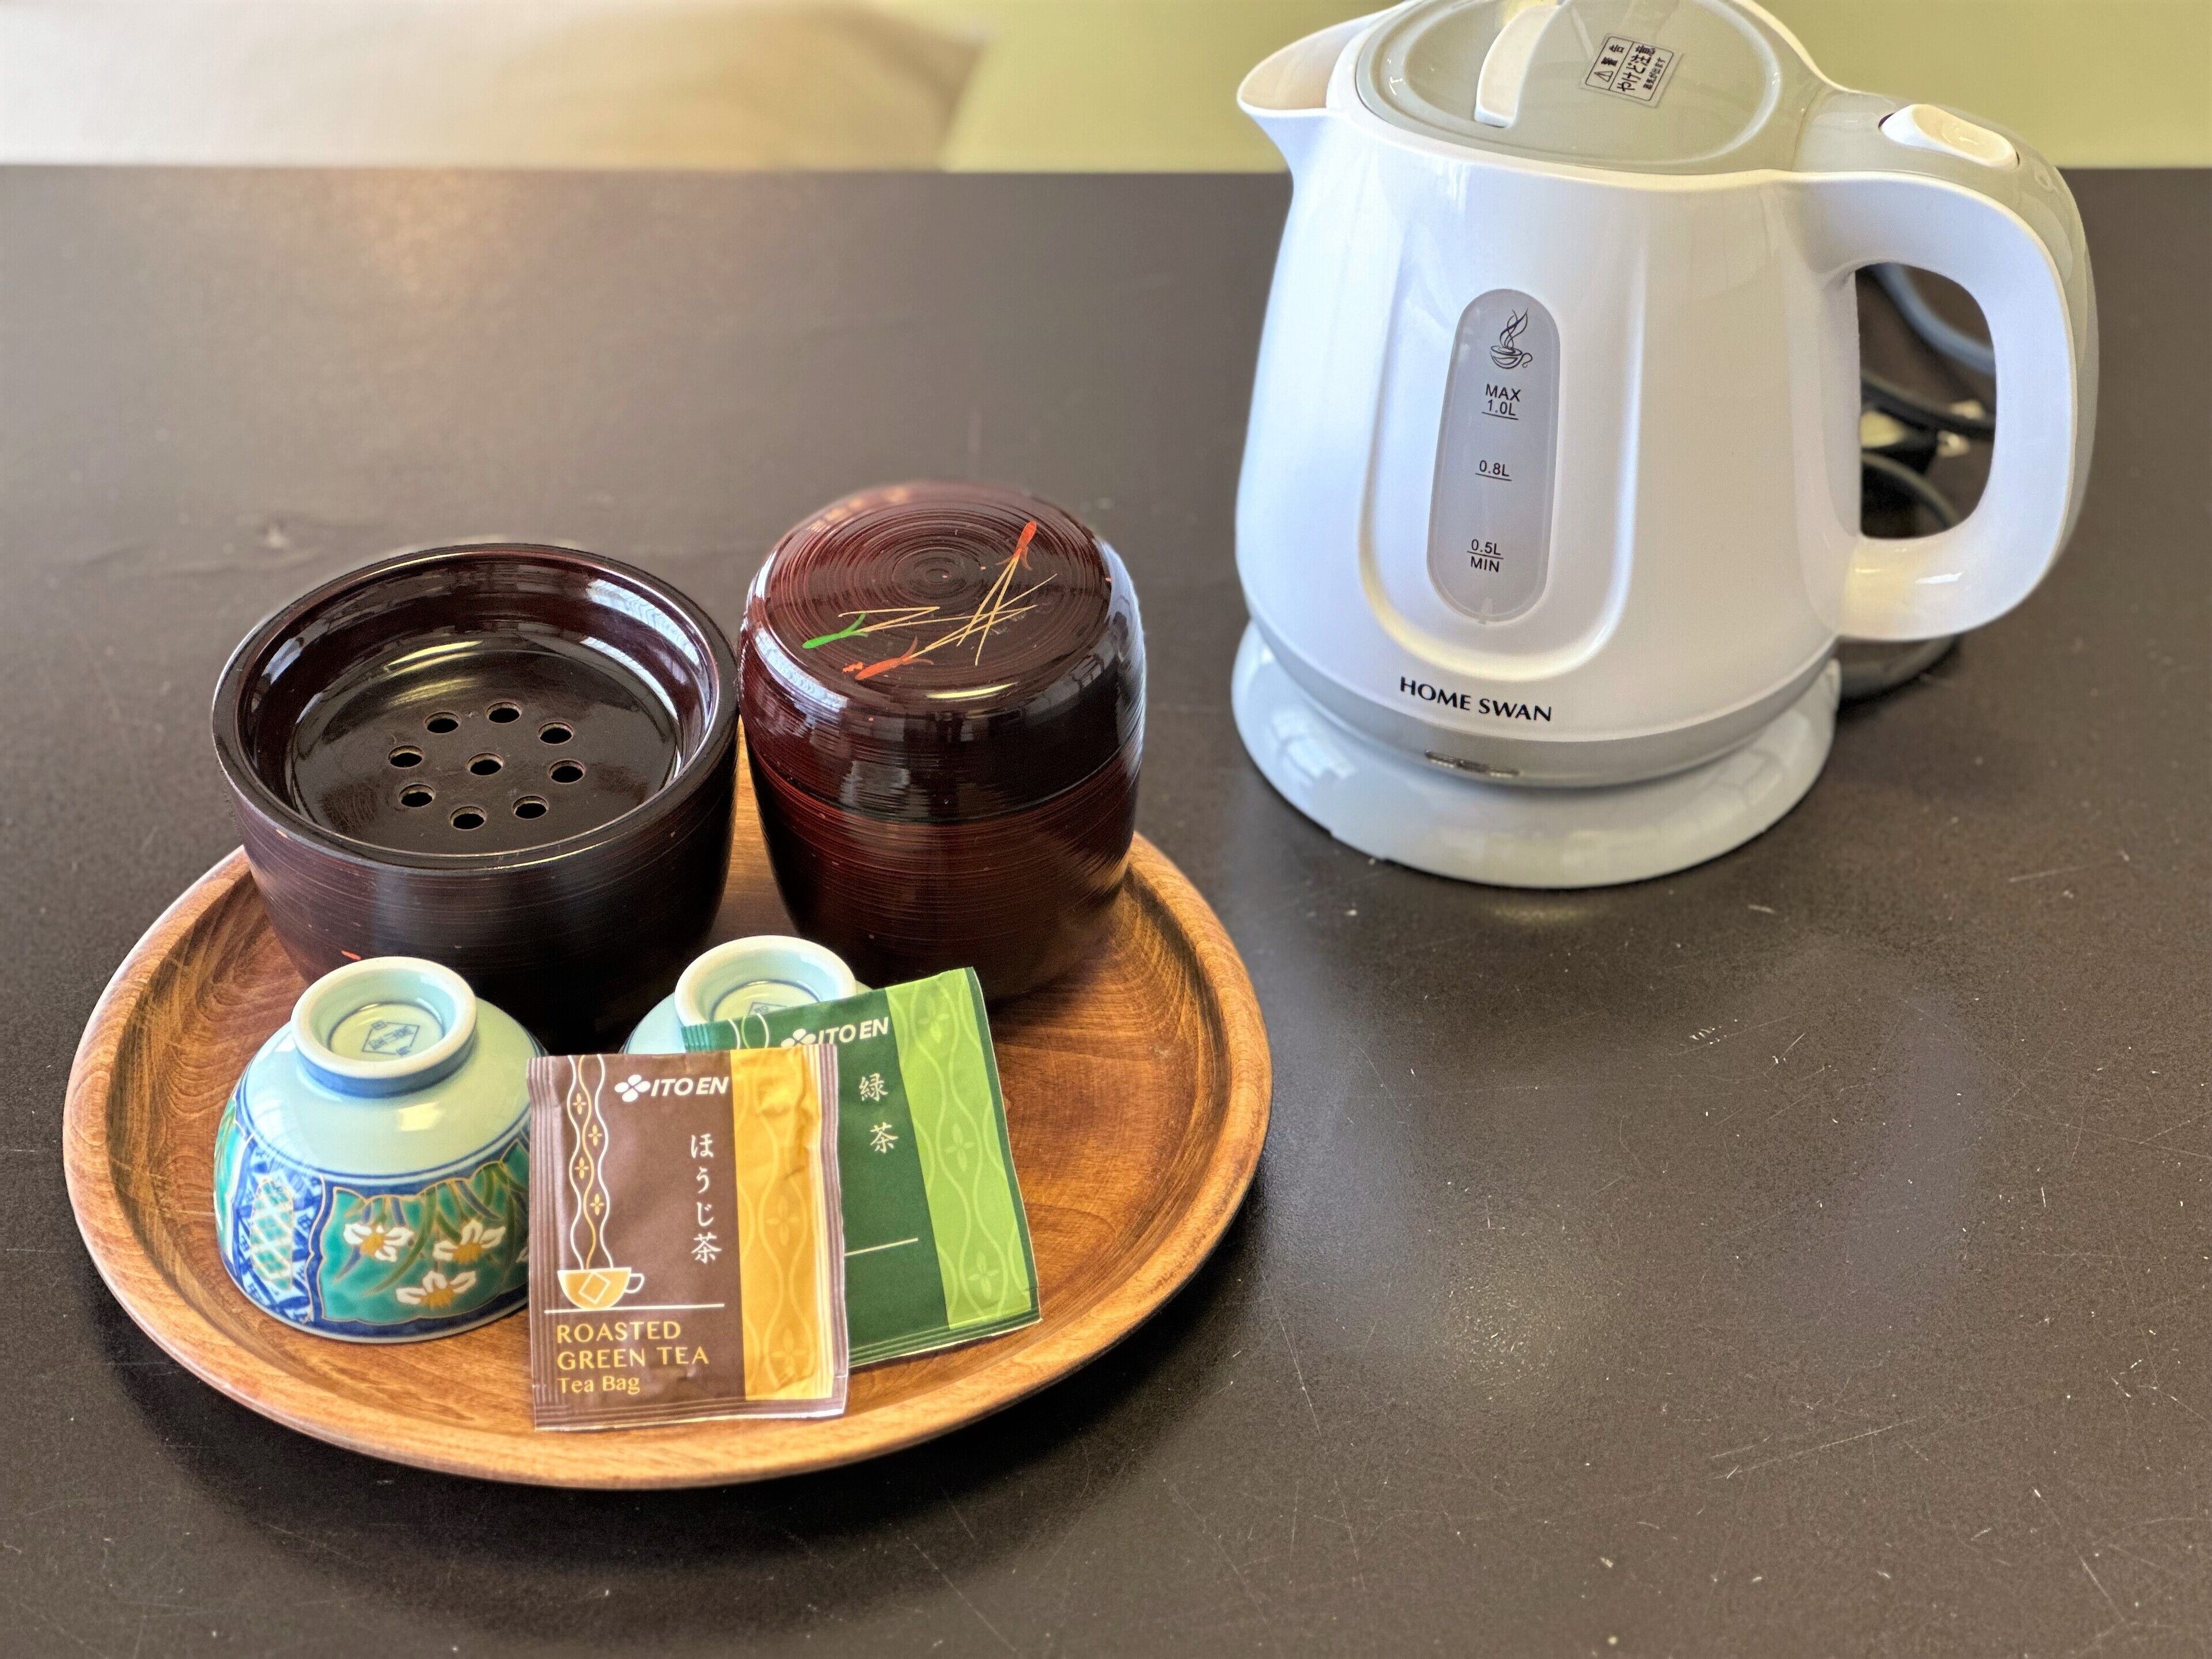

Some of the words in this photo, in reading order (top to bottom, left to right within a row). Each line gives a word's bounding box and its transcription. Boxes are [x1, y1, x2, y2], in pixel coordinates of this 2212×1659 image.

[1601, 44, 1625, 67] 警告
[1616, 45, 1656, 92] やけど注意
[1485, 384, 1521, 402] MAX
[1488, 400, 1517, 416] 1.0L
[1479, 460, 1510, 477] 0.8L
[1471, 539, 1501, 556] 0.5L
[1470, 556, 1500, 573] MIN
[1400, 676, 1471, 711] HOME
[1478, 698, 1552, 722] SWAN
[649, 1078, 693, 1097] ITO
[696, 1076, 729, 1094] EN
[858, 1072, 899, 1154] 緑茶
[690, 1132, 722, 1264] ほうじ茶
[556, 1321, 681, 1344] ROASTED
[556, 1347, 646, 1370] GREEN
[657, 1346, 709, 1365] TEA
[559, 1377, 594, 1395] Tea
[602, 1375, 641, 1395] Bag
